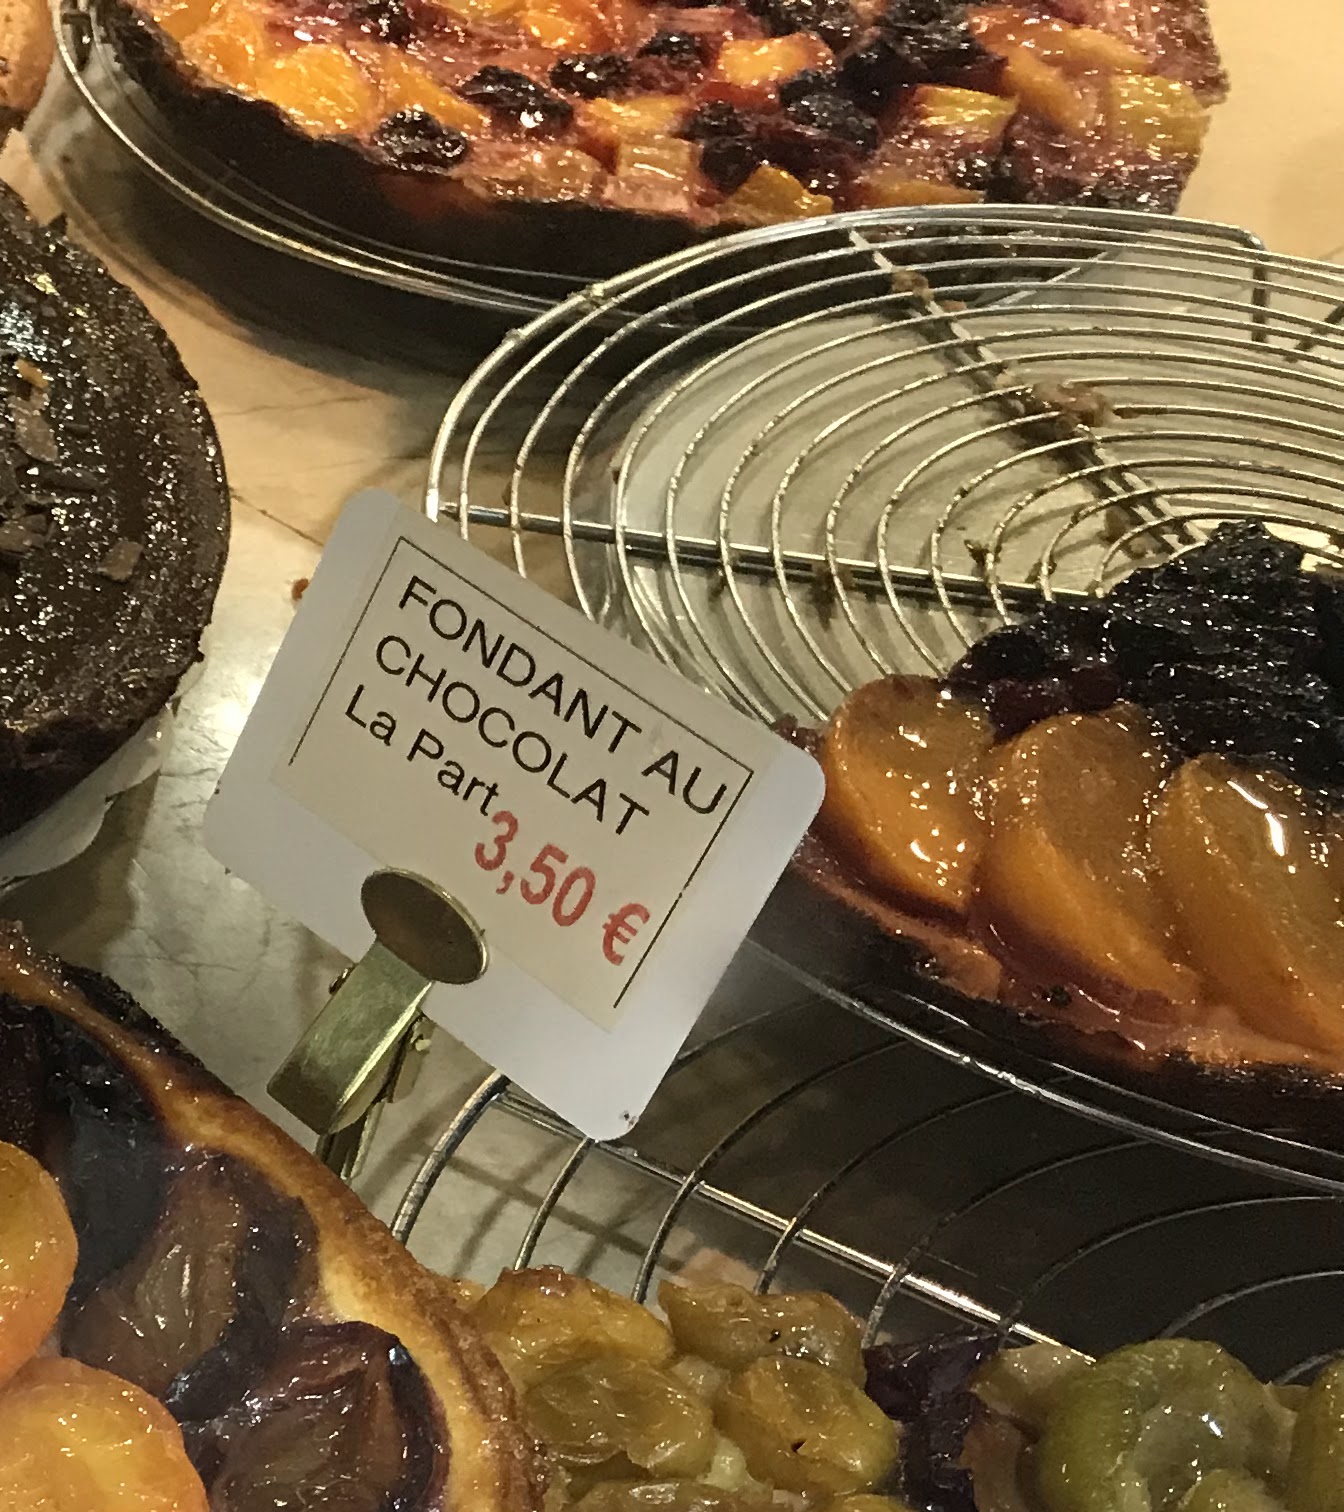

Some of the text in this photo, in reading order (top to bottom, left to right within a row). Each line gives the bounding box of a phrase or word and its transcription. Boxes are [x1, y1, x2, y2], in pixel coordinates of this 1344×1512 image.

[344, 684, 503, 818] La Part
[373, 633, 651, 837] CHOCOLAT
[397, 574, 728, 817] FONDANT AU
[474, 810, 652, 966] 3,50 €
